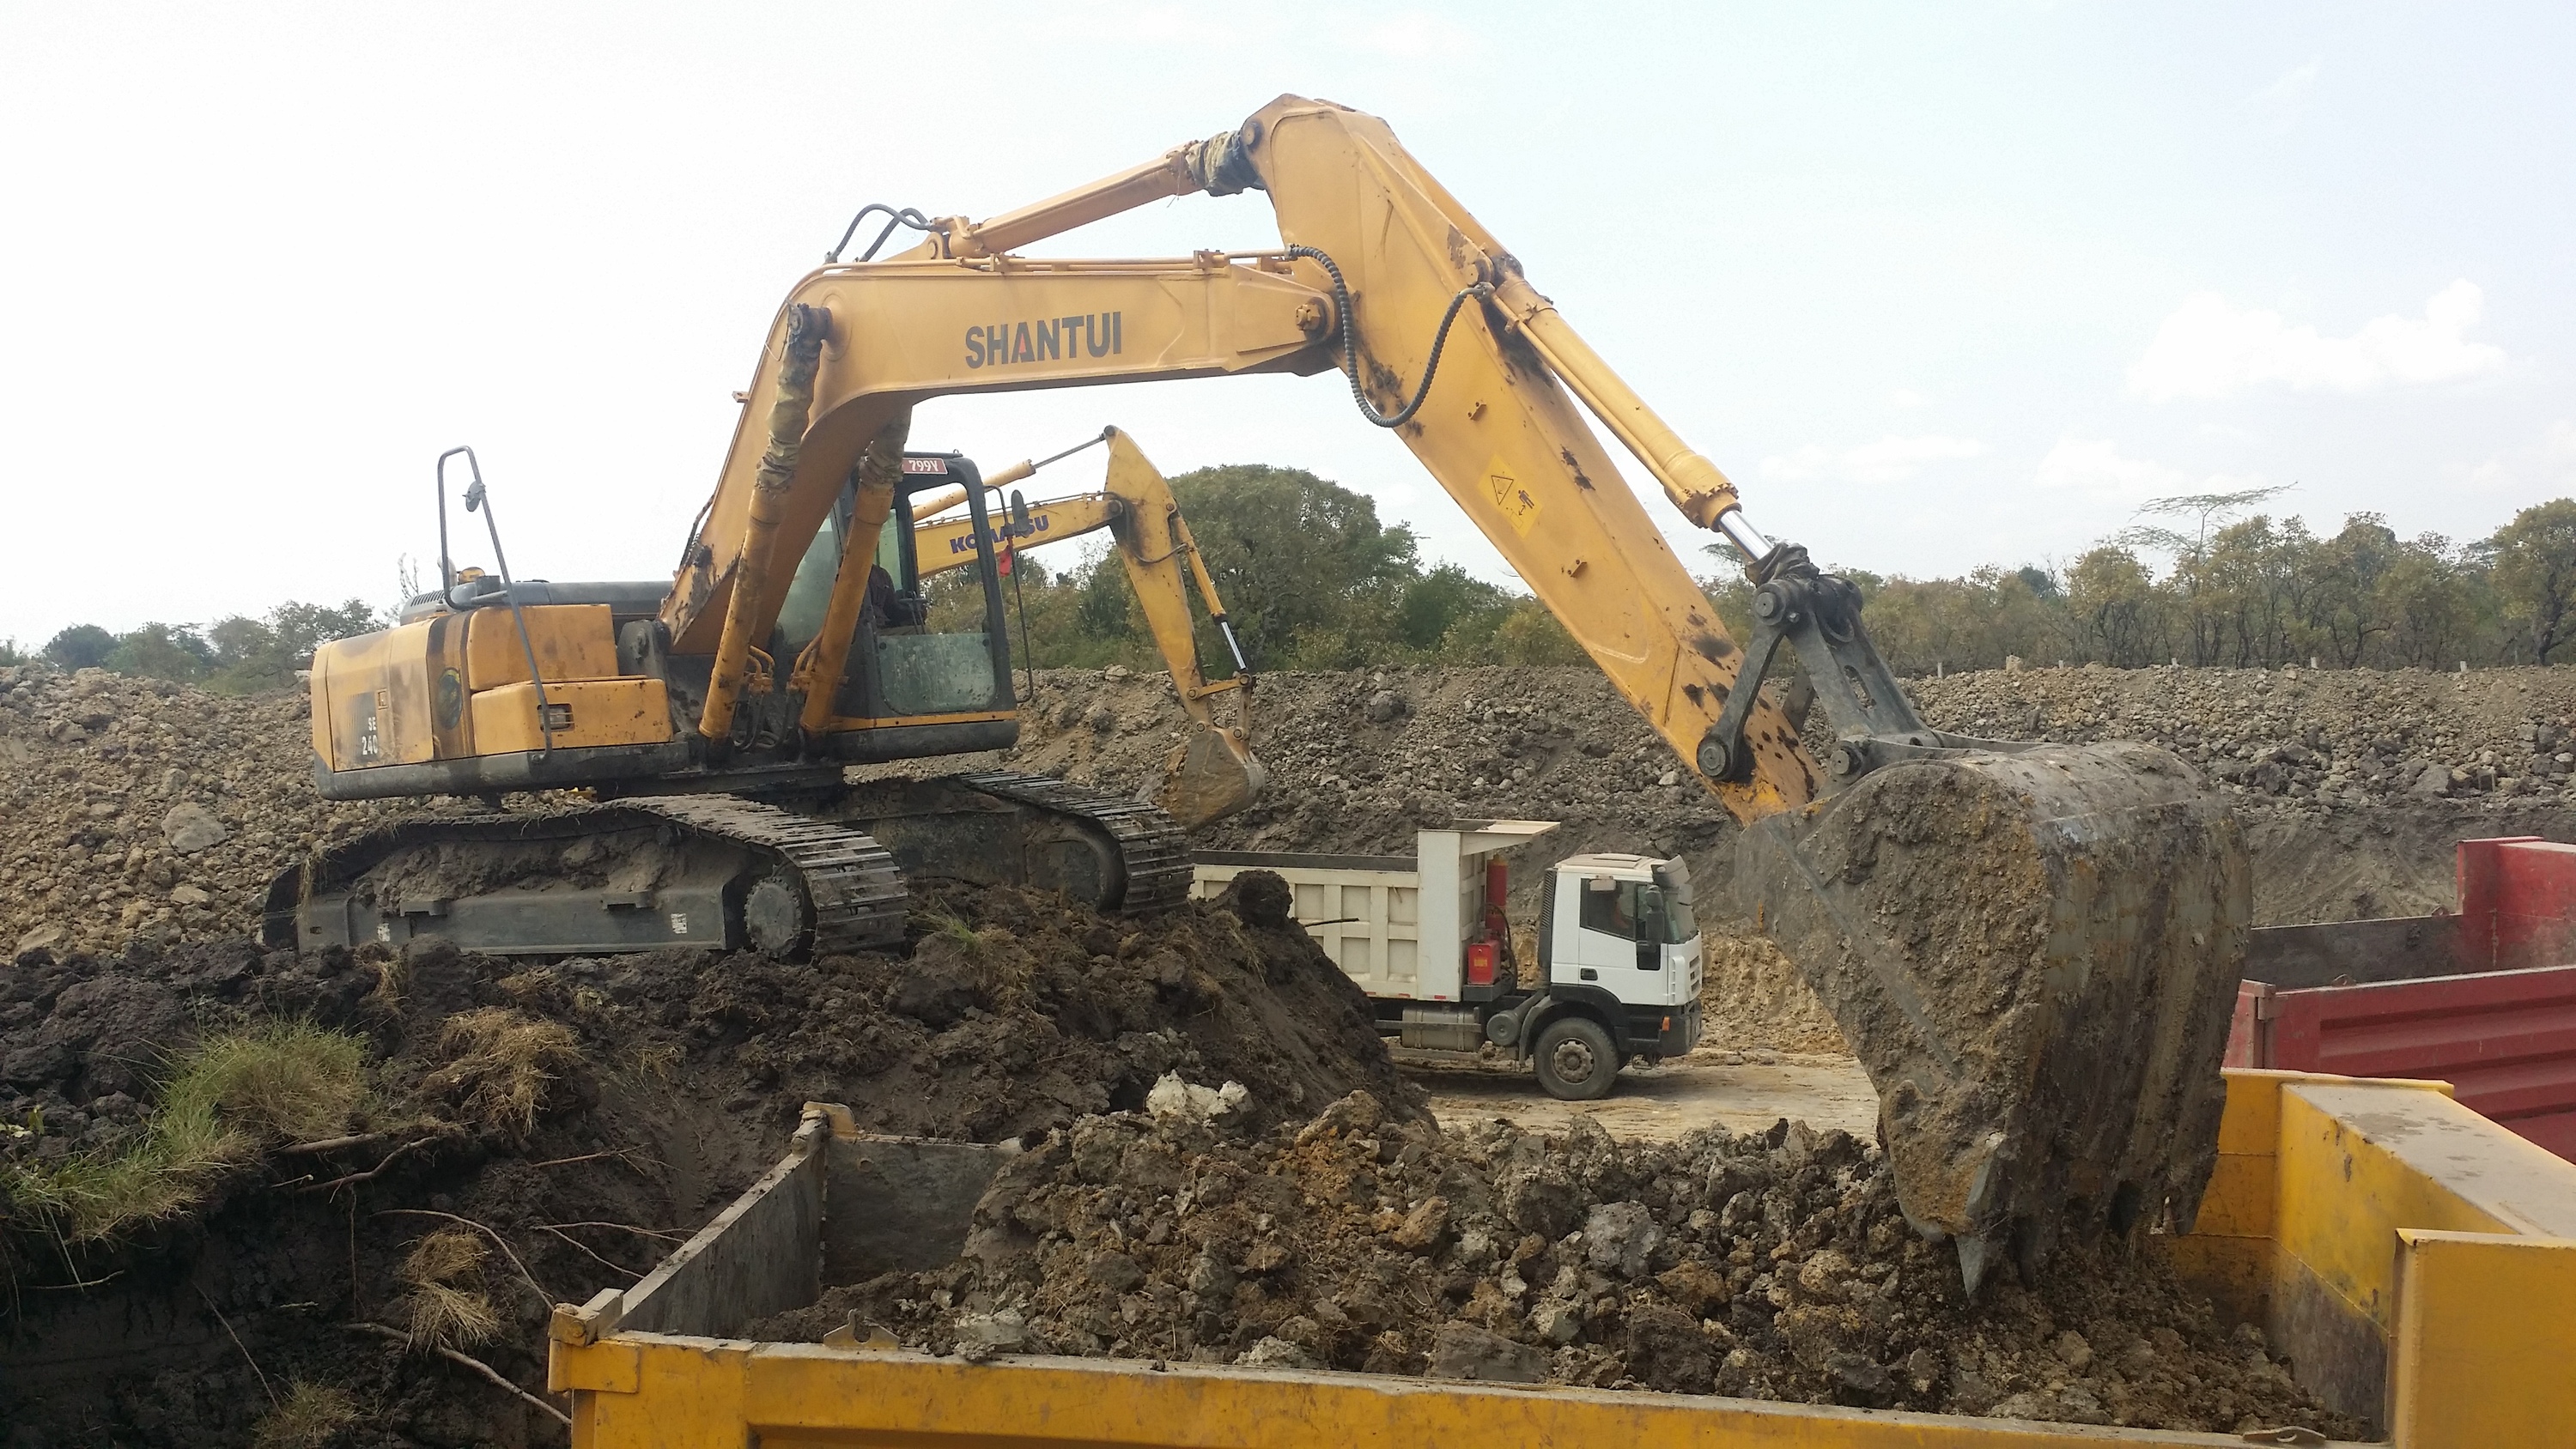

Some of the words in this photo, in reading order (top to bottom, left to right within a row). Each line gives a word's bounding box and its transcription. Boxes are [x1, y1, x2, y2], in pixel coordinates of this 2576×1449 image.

[965, 311, 1121, 369] SHANTUI
[908, 459, 939, 472] 799Y
[368, 716, 377, 731] SE
